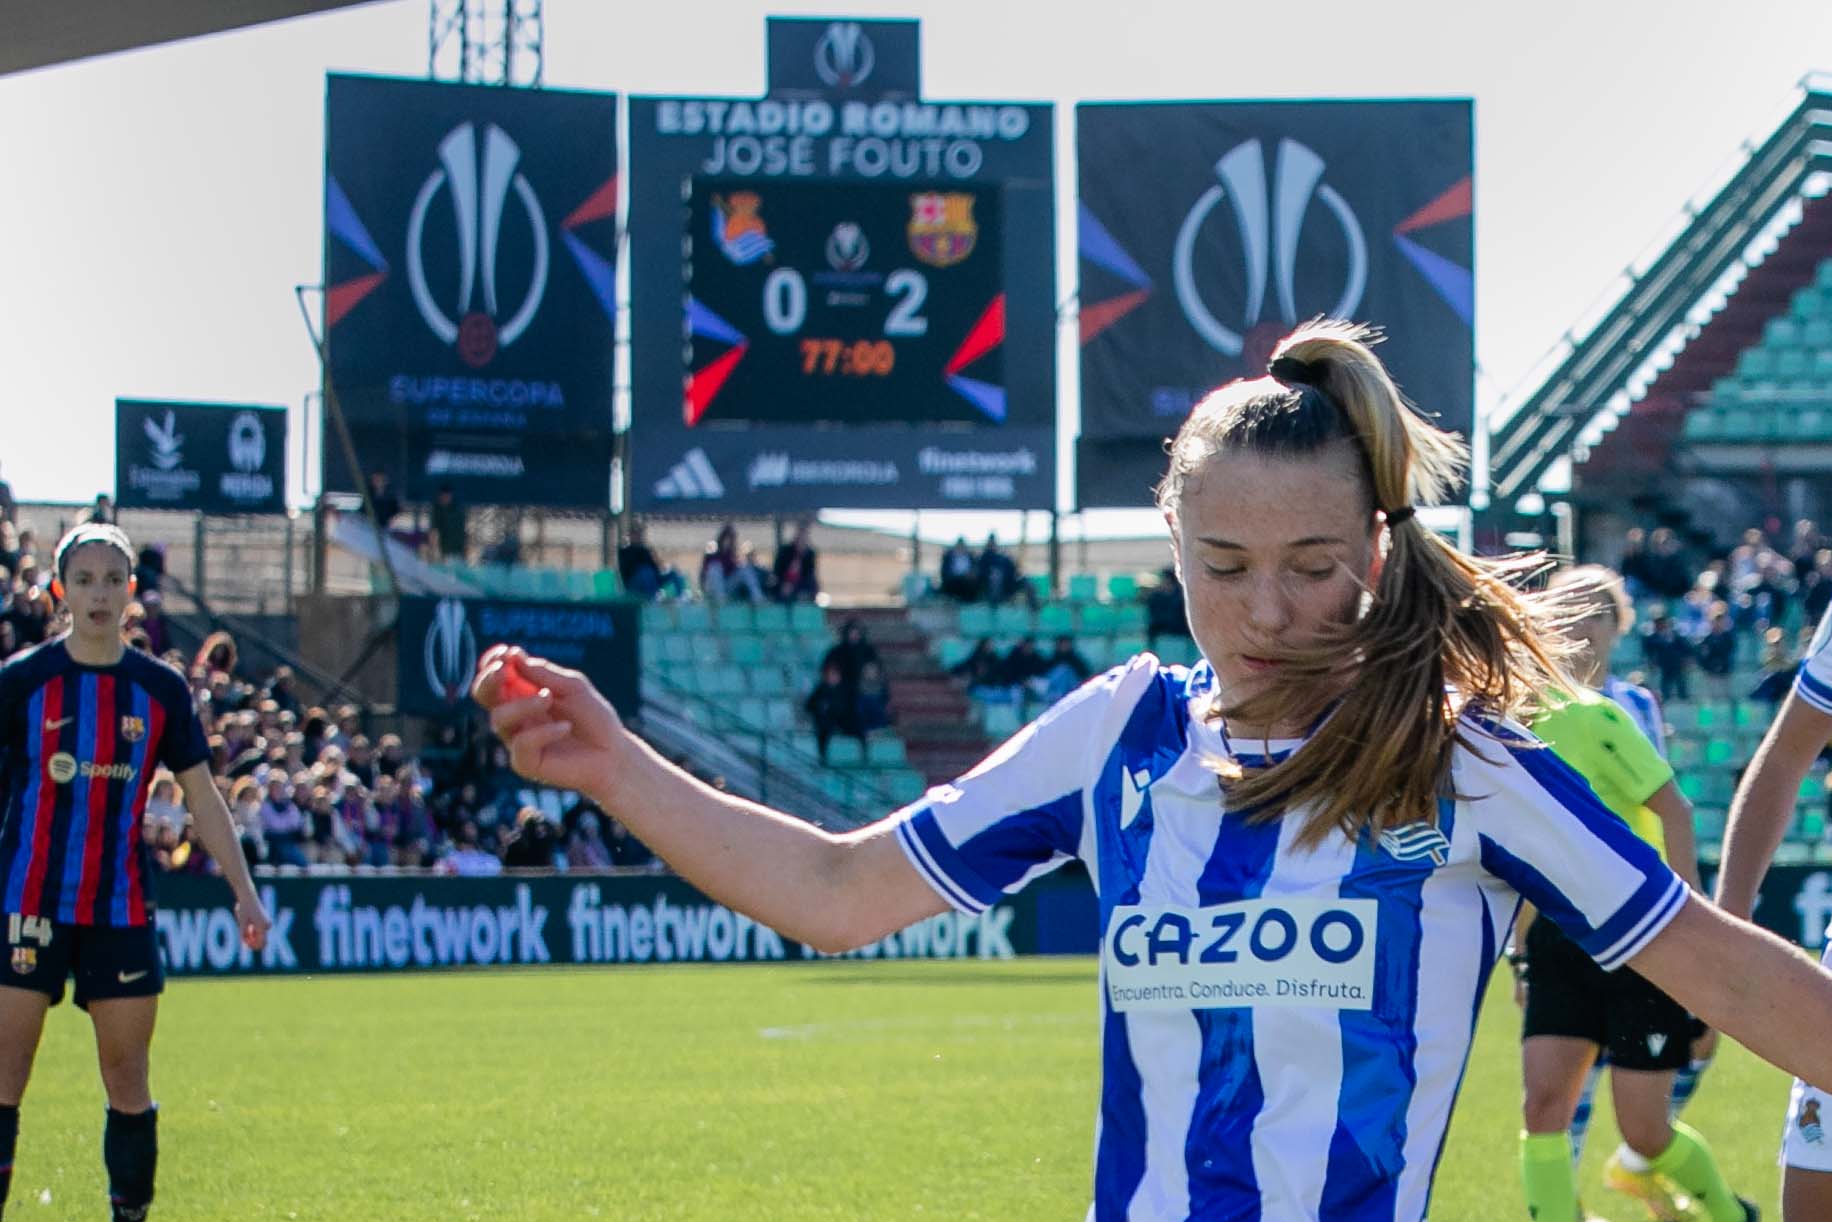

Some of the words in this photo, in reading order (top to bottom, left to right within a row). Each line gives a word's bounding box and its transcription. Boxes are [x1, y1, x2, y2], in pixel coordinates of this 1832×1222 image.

[656, 100, 834, 136] ESTADIO
[841, 102, 1030, 140] ROMANO
[828, 137, 983, 178] FOUTO
[763, 267, 807, 334] 0
[883, 269, 928, 336] 2
[80, 760, 138, 783] Spotify
[8, 912, 53, 947] 14
[314, 883, 551, 968] finetwork
[1113, 908, 1364, 967] CAZOO
[1276, 978, 1367, 1000] Disfruta.
